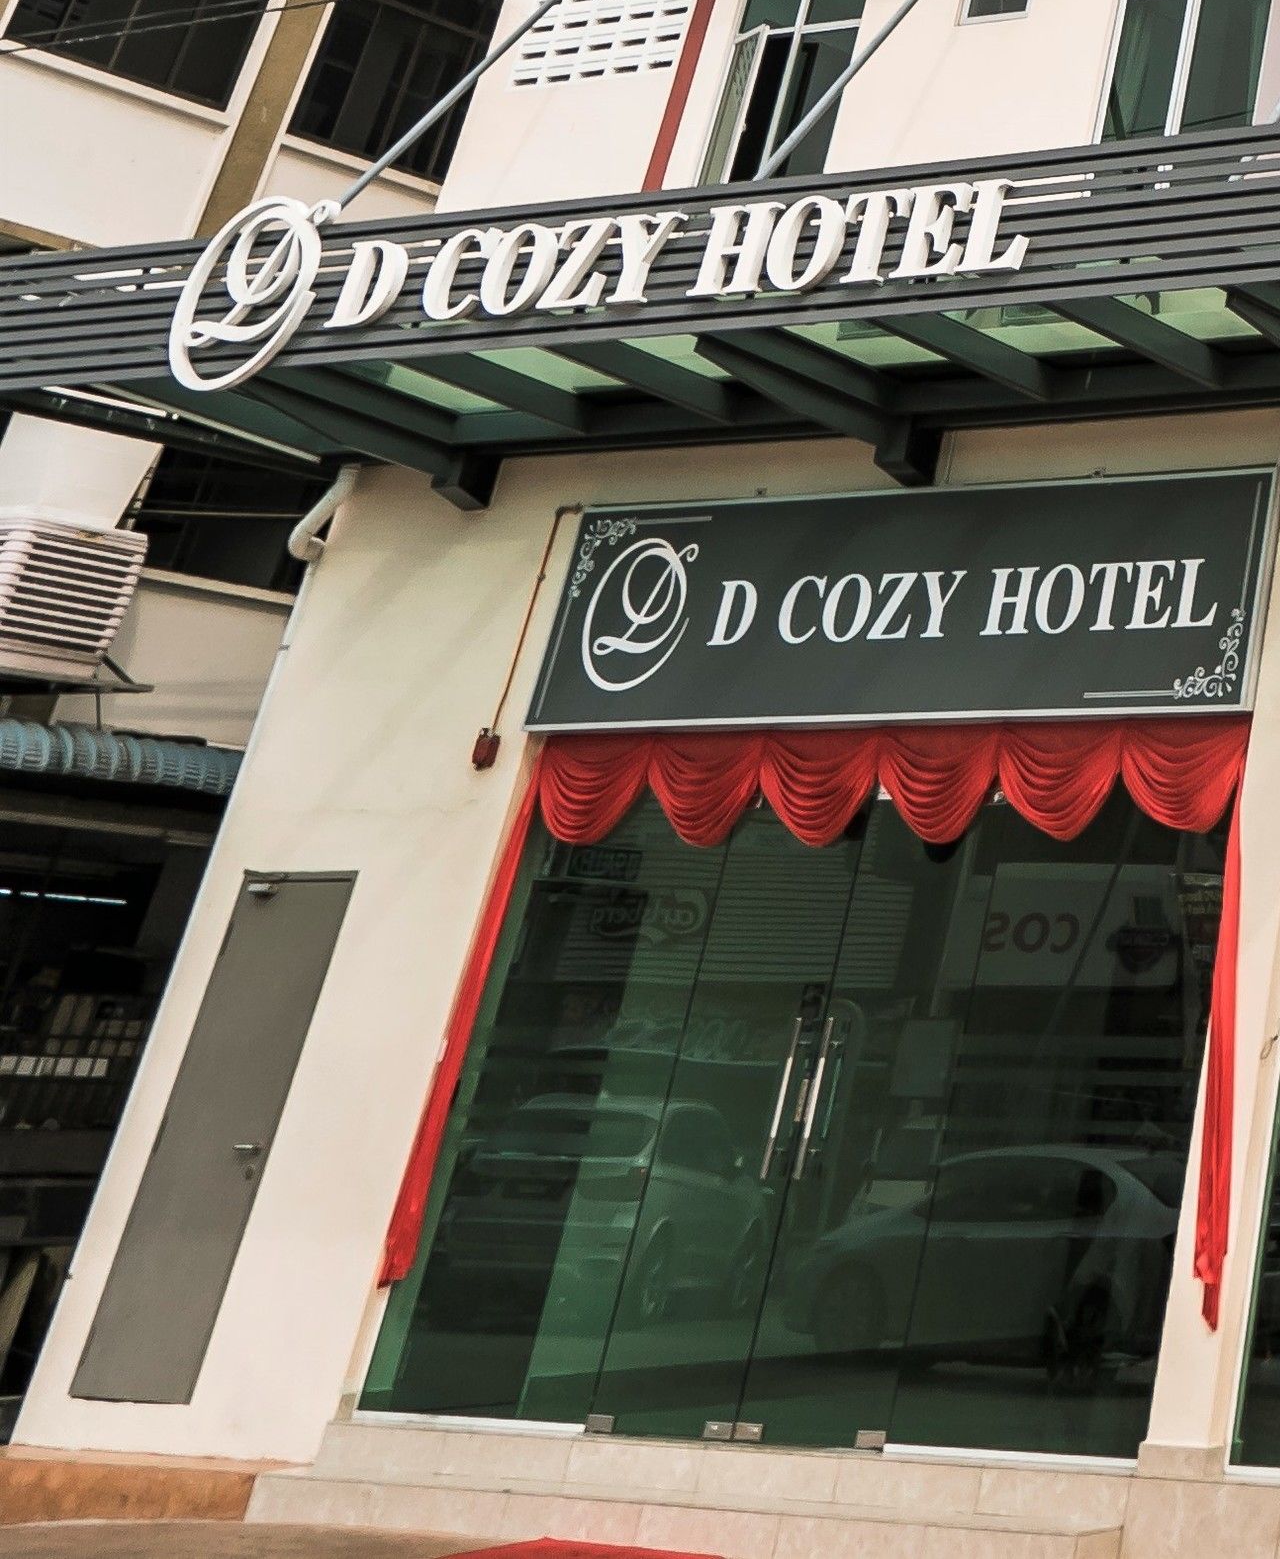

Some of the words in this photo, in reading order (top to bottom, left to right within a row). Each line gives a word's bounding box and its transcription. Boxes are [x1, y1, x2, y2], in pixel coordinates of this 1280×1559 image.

[324, 240, 410, 328] D
[422, 212, 688, 321] COZY
[686, 178, 1030, 298] HOTEL
[707, 579, 756, 646] D
[777, 568, 965, 646] COZY
[979, 558, 1218, 636] HOTEL
